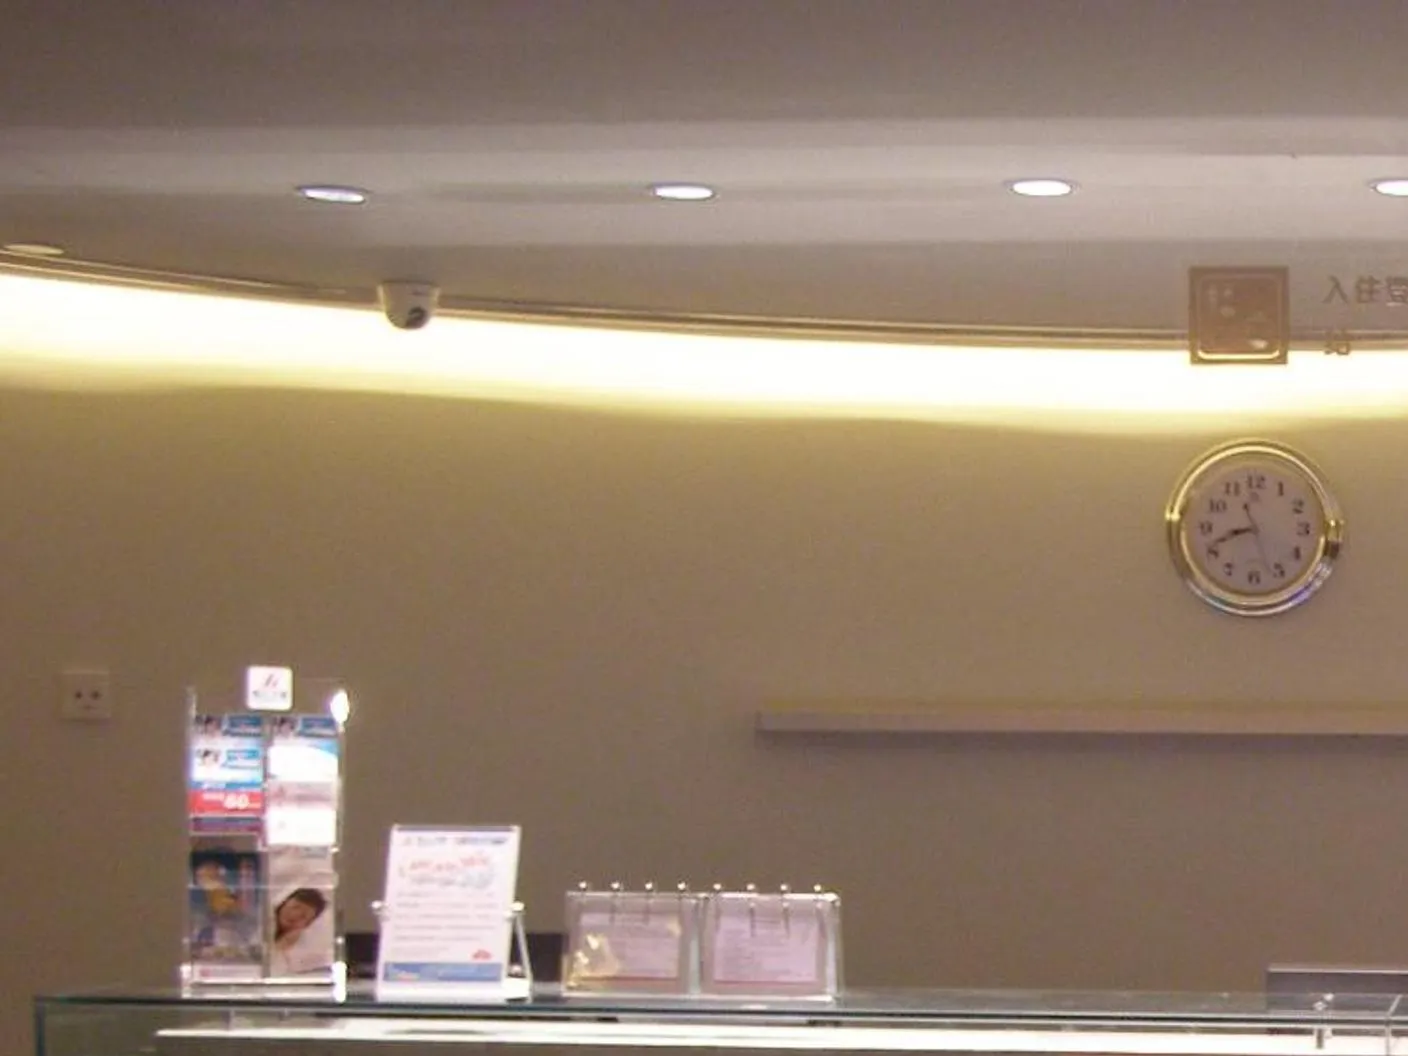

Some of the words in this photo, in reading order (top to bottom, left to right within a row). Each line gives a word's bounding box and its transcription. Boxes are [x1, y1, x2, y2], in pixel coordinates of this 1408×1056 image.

[1225, 481, 1240, 496] 11
[1247, 475, 1267, 490] 12
[1209, 499, 1227, 513] 10
